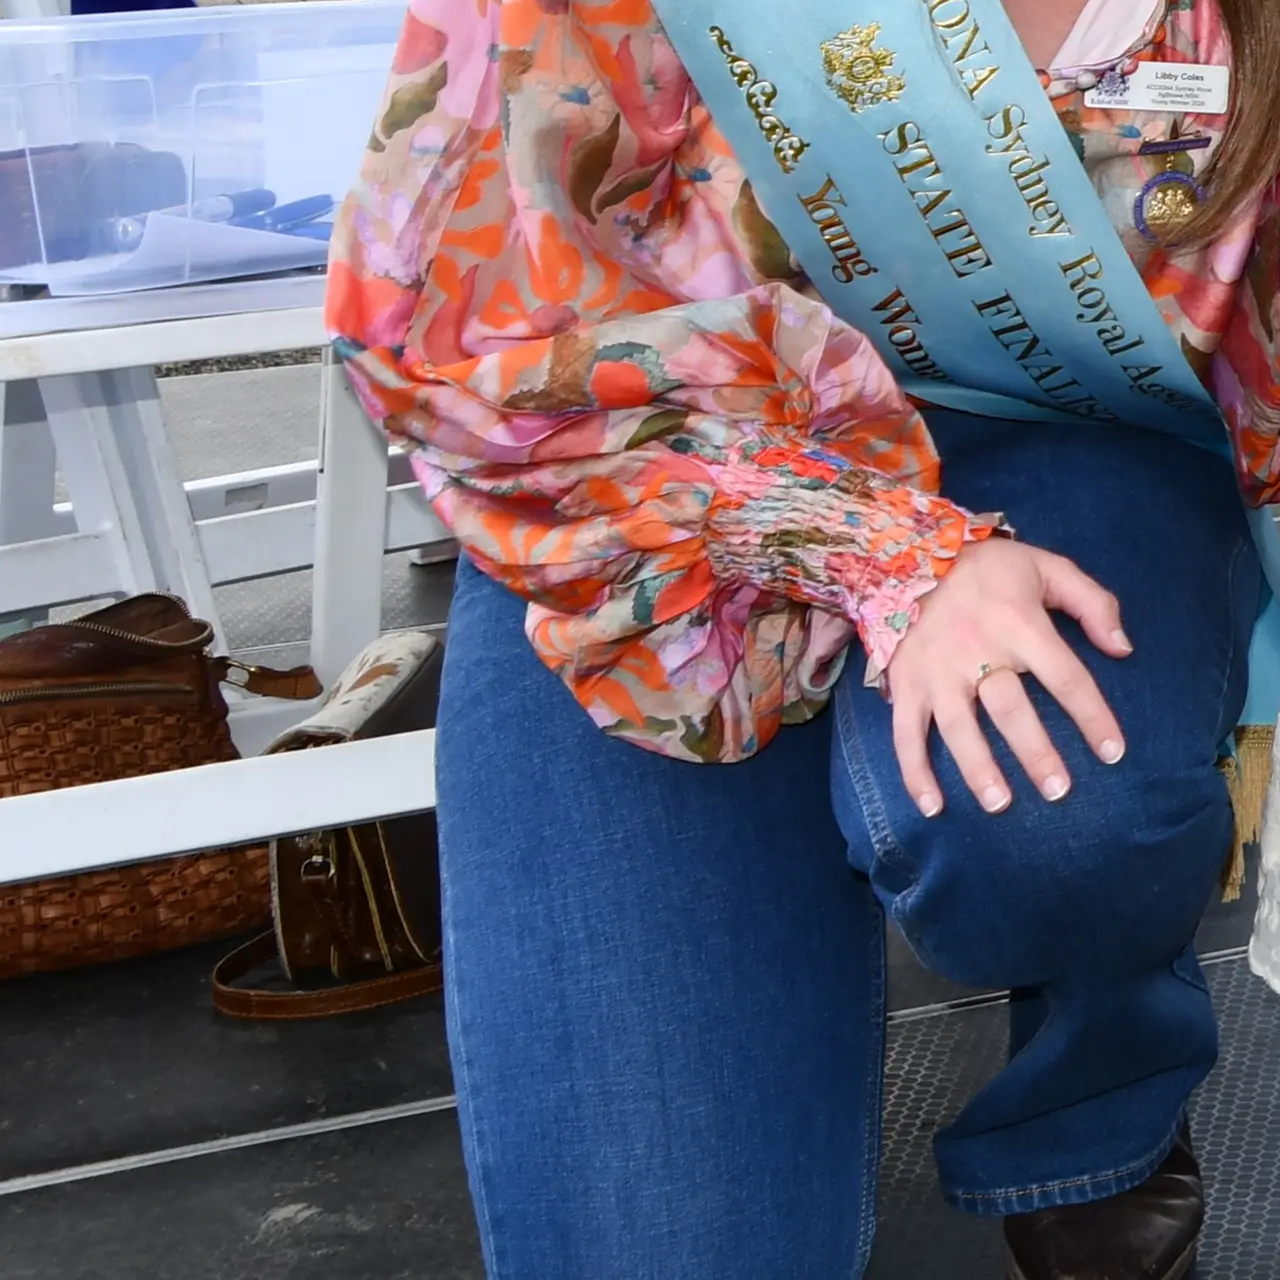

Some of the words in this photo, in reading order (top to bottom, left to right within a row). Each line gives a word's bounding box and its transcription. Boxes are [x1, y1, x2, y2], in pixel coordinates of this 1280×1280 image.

[1155, 72, 1178, 82] Libby
[797, 174, 878, 286] Young
[880, 120, 995, 280] STATE
[984, 103, 1075, 240] Sydney
[1058, 246, 1146, 357] Royal
